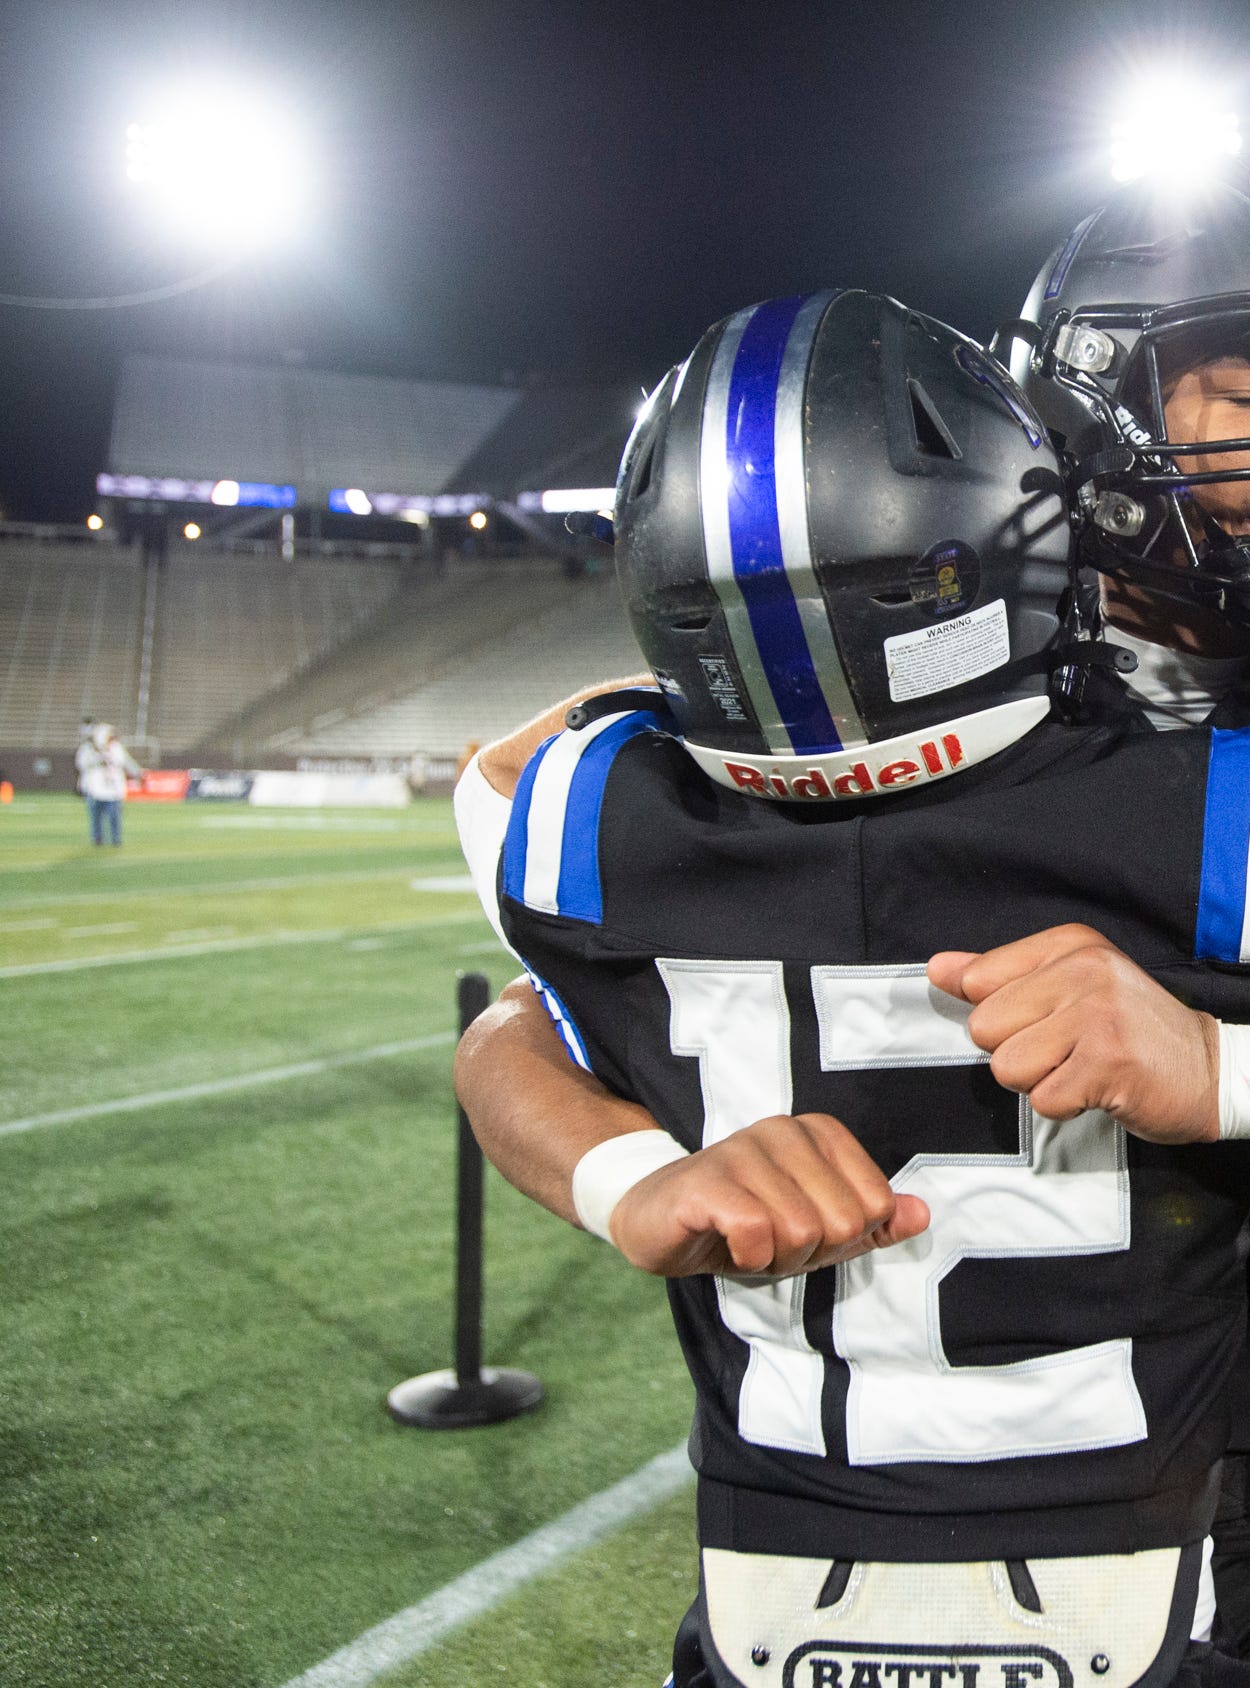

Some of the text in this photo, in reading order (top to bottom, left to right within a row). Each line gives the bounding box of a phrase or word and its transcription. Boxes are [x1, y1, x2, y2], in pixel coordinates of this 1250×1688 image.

[927, 617, 972, 638] WARNING
[723, 733, 965, 799] Riddell
[657, 958, 1148, 1466] 12
